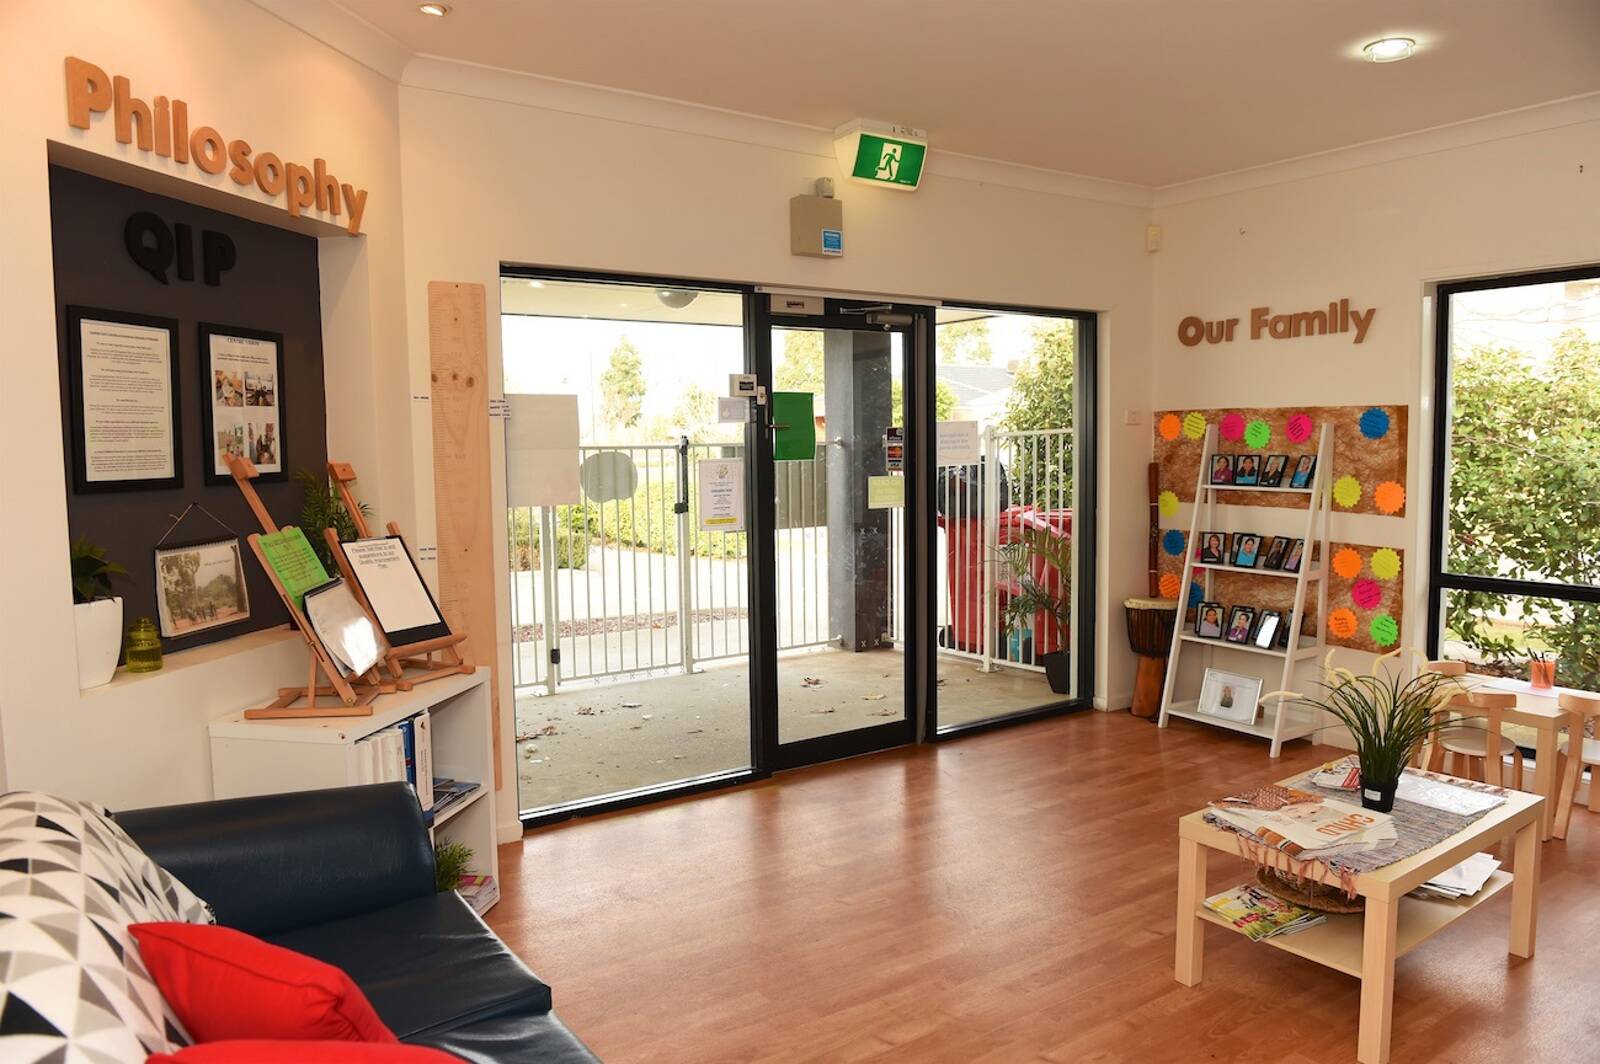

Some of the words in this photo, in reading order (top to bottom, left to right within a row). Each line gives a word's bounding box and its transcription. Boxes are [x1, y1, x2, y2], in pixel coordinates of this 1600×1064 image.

[65, 56, 368, 235] Philosophy
[1177, 316, 1239, 347] Our
[1250, 298, 1377, 344] Family
